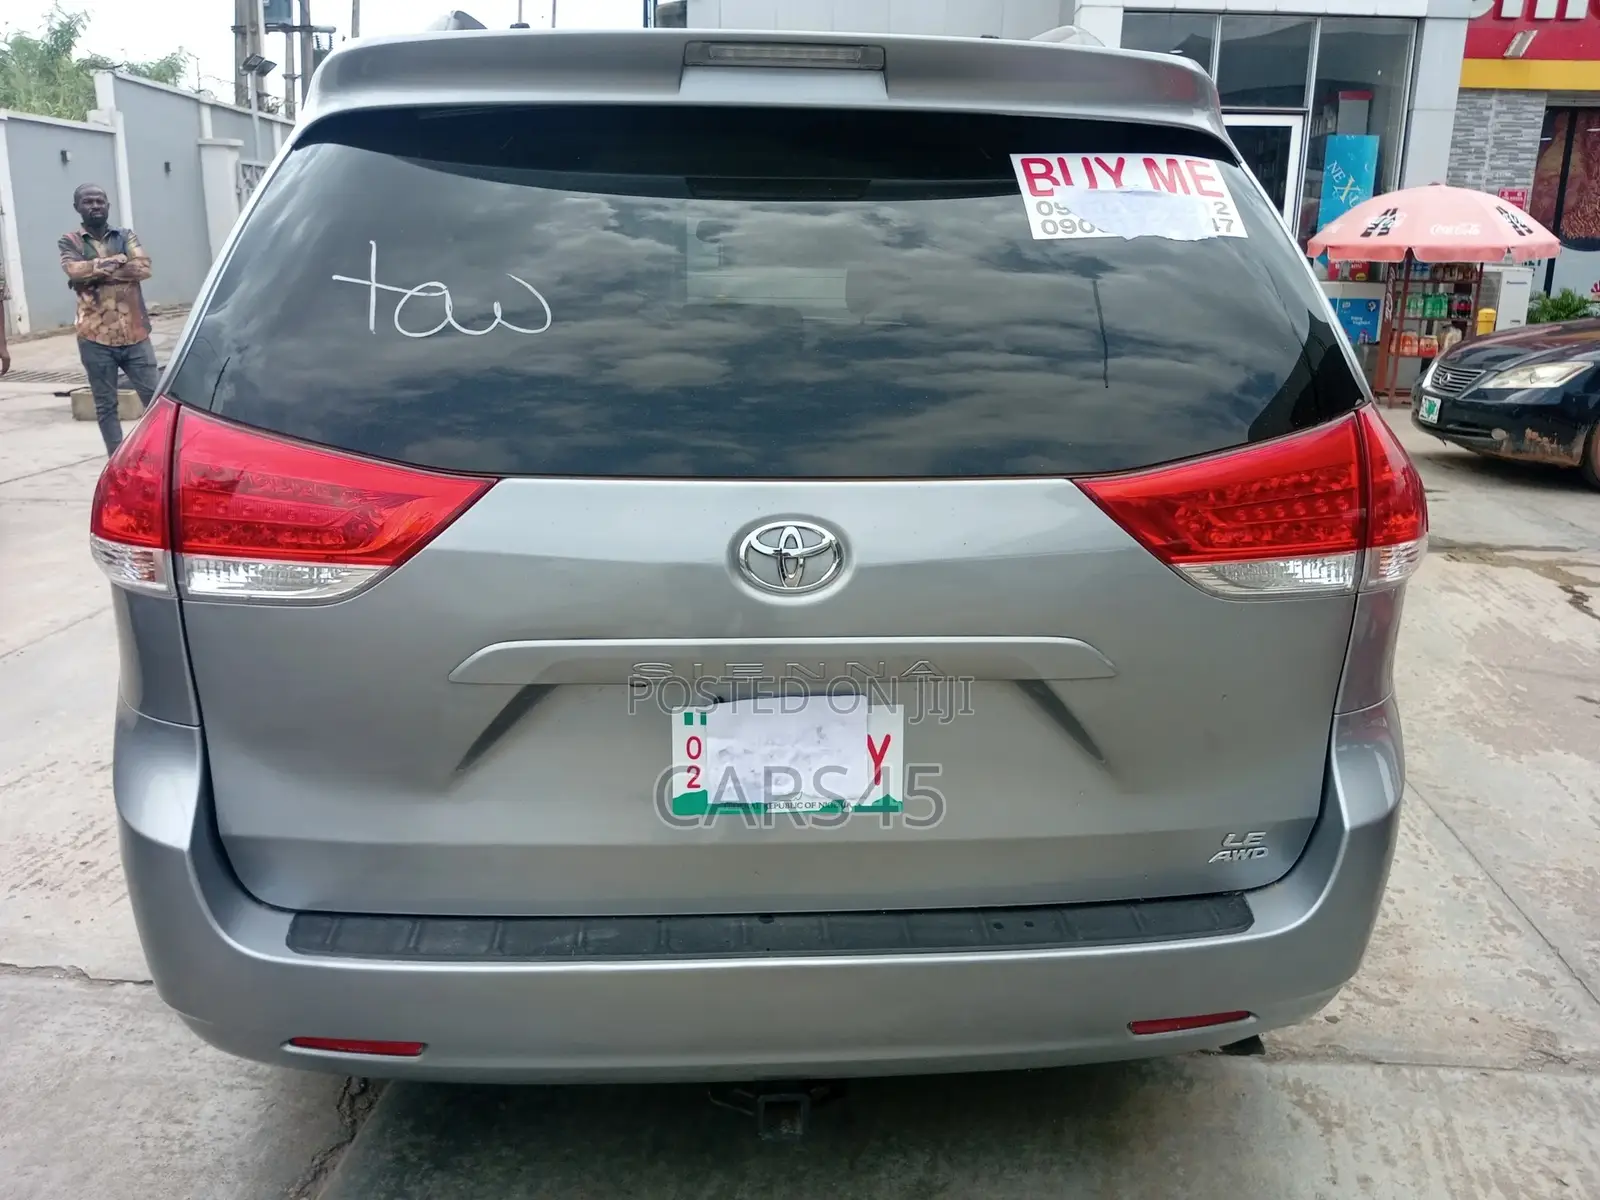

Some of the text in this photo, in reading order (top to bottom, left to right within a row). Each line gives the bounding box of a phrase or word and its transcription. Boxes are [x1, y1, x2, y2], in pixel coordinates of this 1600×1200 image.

[1020, 156, 1225, 198] BUY ME
[631, 660, 946, 681] SIENNA
[804, 801, 816, 809] OF
[1222, 831, 1266, 848] LE
[1208, 846, 1269, 864] AWD
